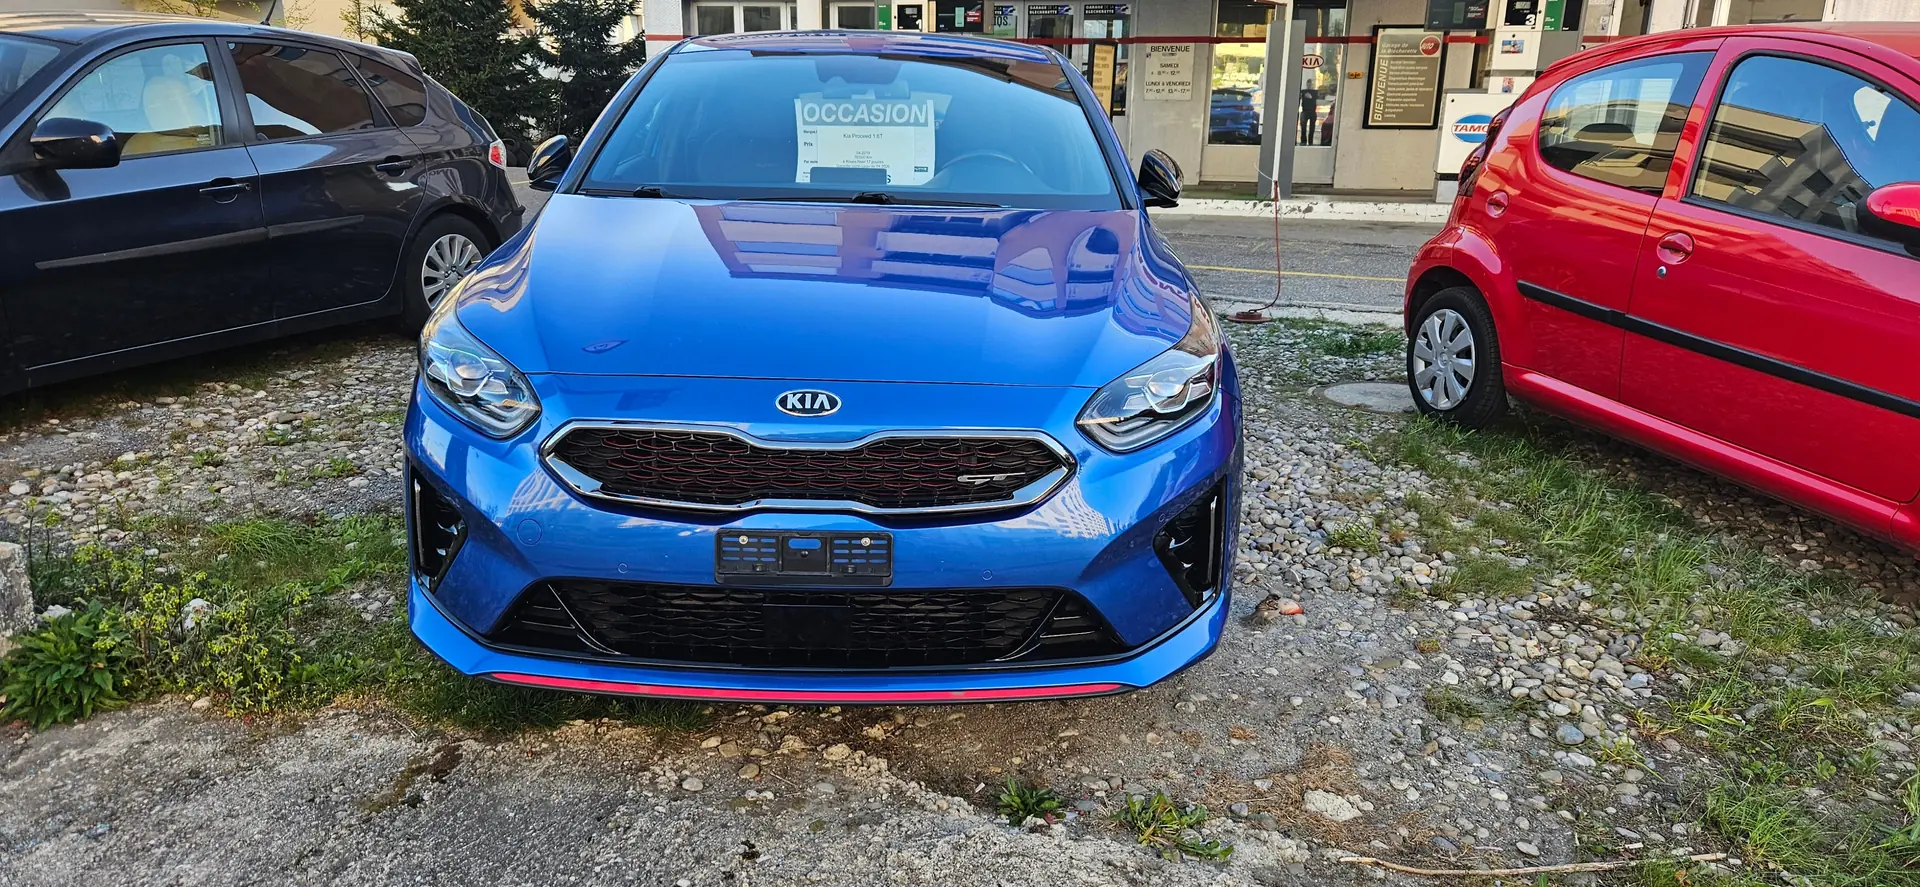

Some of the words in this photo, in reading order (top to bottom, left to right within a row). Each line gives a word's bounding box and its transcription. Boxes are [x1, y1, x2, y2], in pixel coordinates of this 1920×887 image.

[1525, 14, 1536, 25] 3
[1150, 45, 1191, 53] BIENVENUE
[1302, 57, 1320, 66] KIA
[1374, 59, 1389, 121] BIENVENUE
[803, 103, 927, 123] OCCASION
[786, 393, 831, 410] KIA
